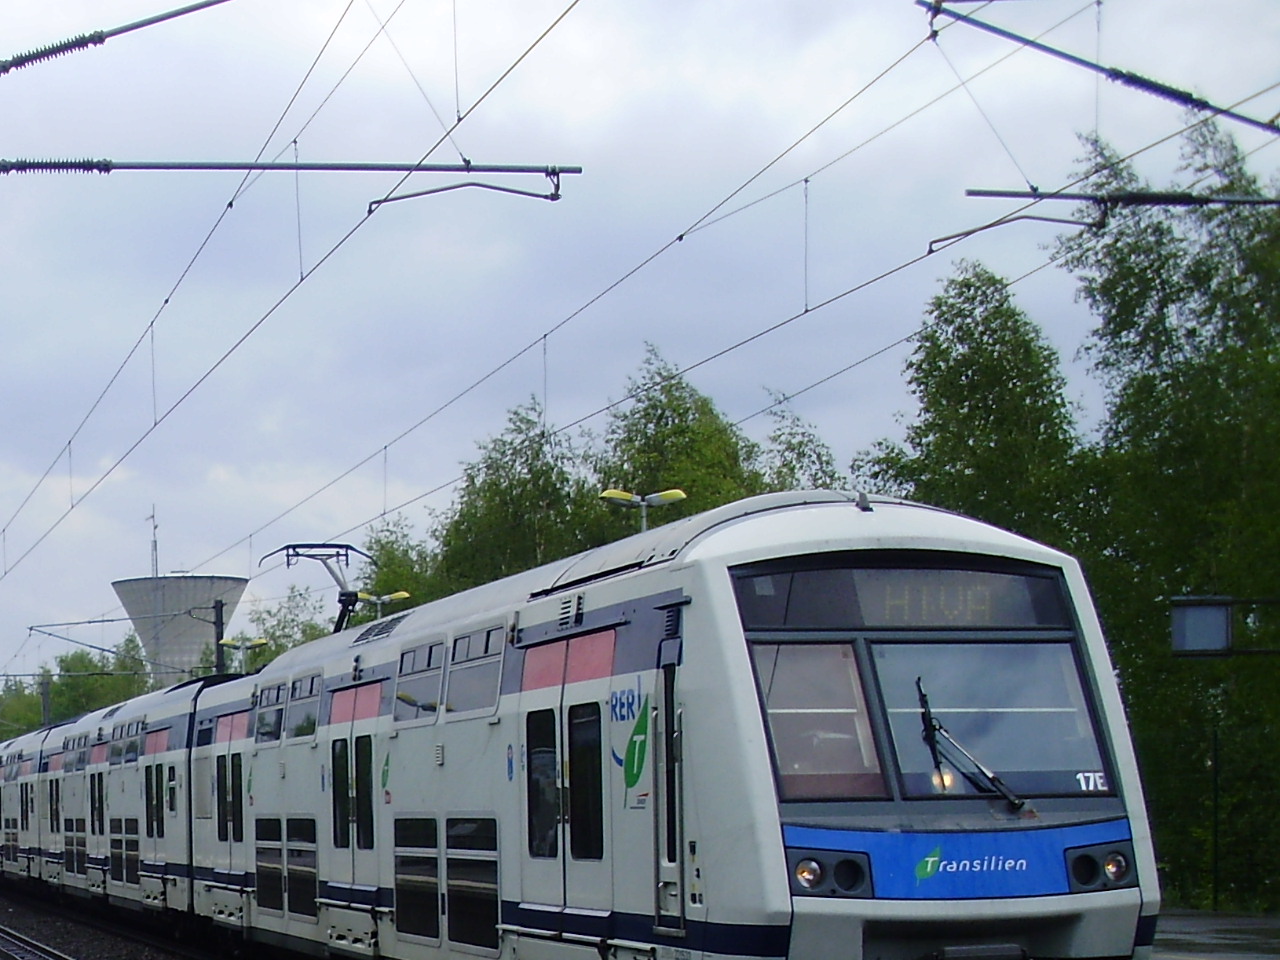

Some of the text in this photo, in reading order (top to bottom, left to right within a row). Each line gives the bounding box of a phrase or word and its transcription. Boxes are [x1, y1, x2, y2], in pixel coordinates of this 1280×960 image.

[611, 689, 635, 722] RER
[1075, 772, 1109, 790] 17E
[924, 856, 1027, 872] Transilien
